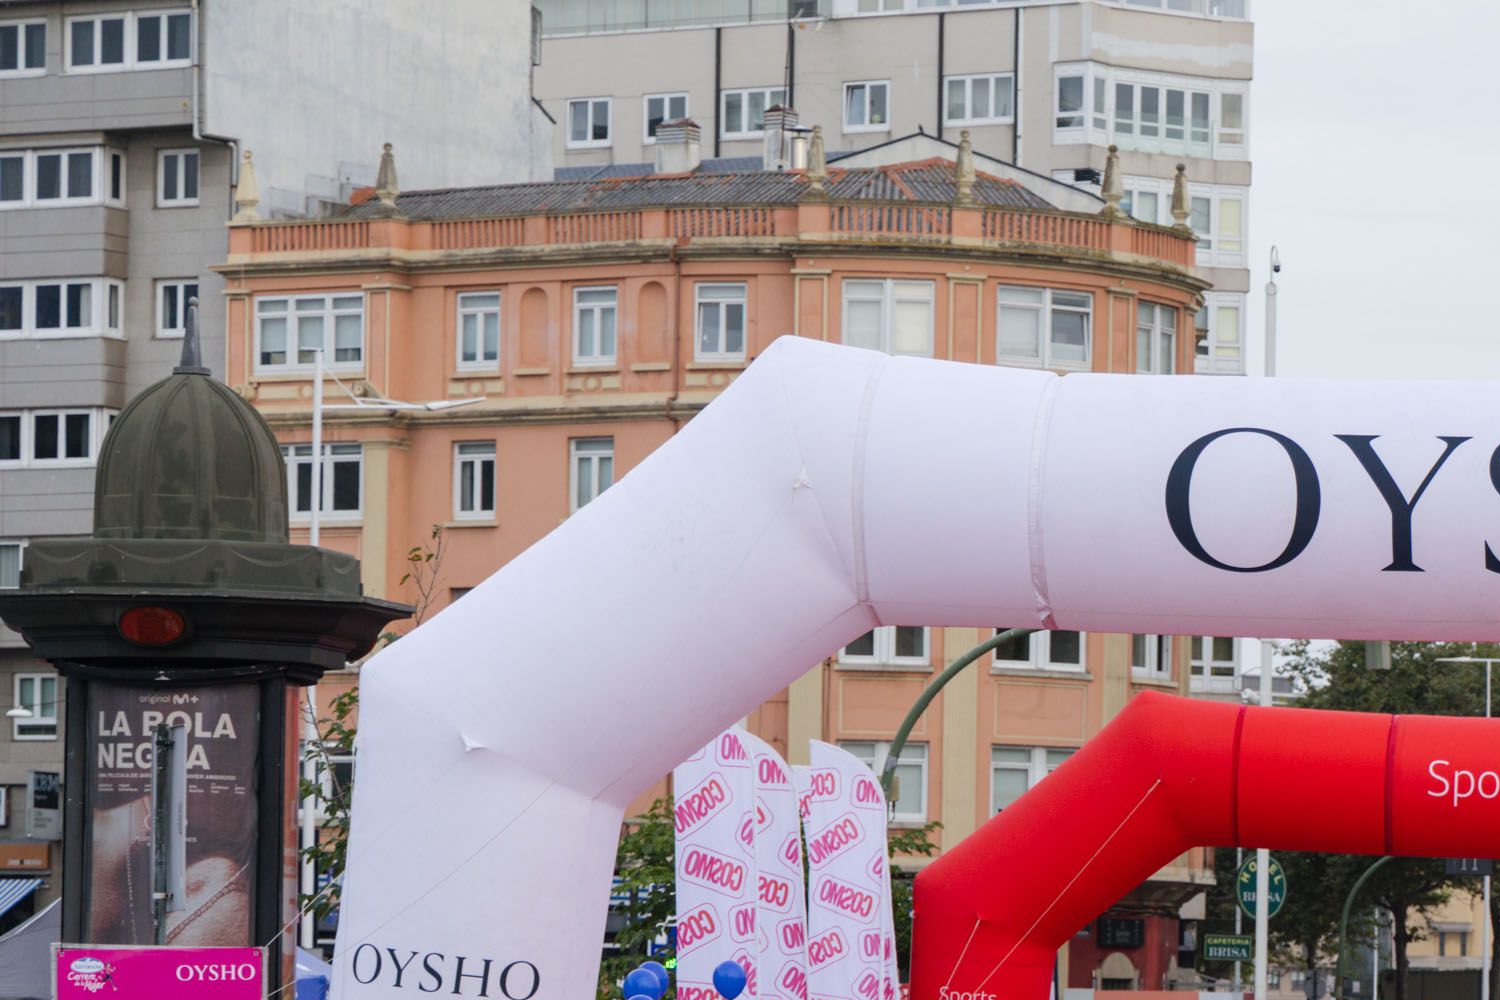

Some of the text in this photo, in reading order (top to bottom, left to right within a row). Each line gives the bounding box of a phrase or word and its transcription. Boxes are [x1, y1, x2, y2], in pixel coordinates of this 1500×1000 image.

[139, 694, 170, 703] original
[98, 711, 237, 739] LA BOLA
[98, 743, 211, 770] NEGA
[1240, 861, 1282, 885] HOEL
[1208, 946, 1248, 957] BRISA
[176, 964, 256, 982] OYSHO
